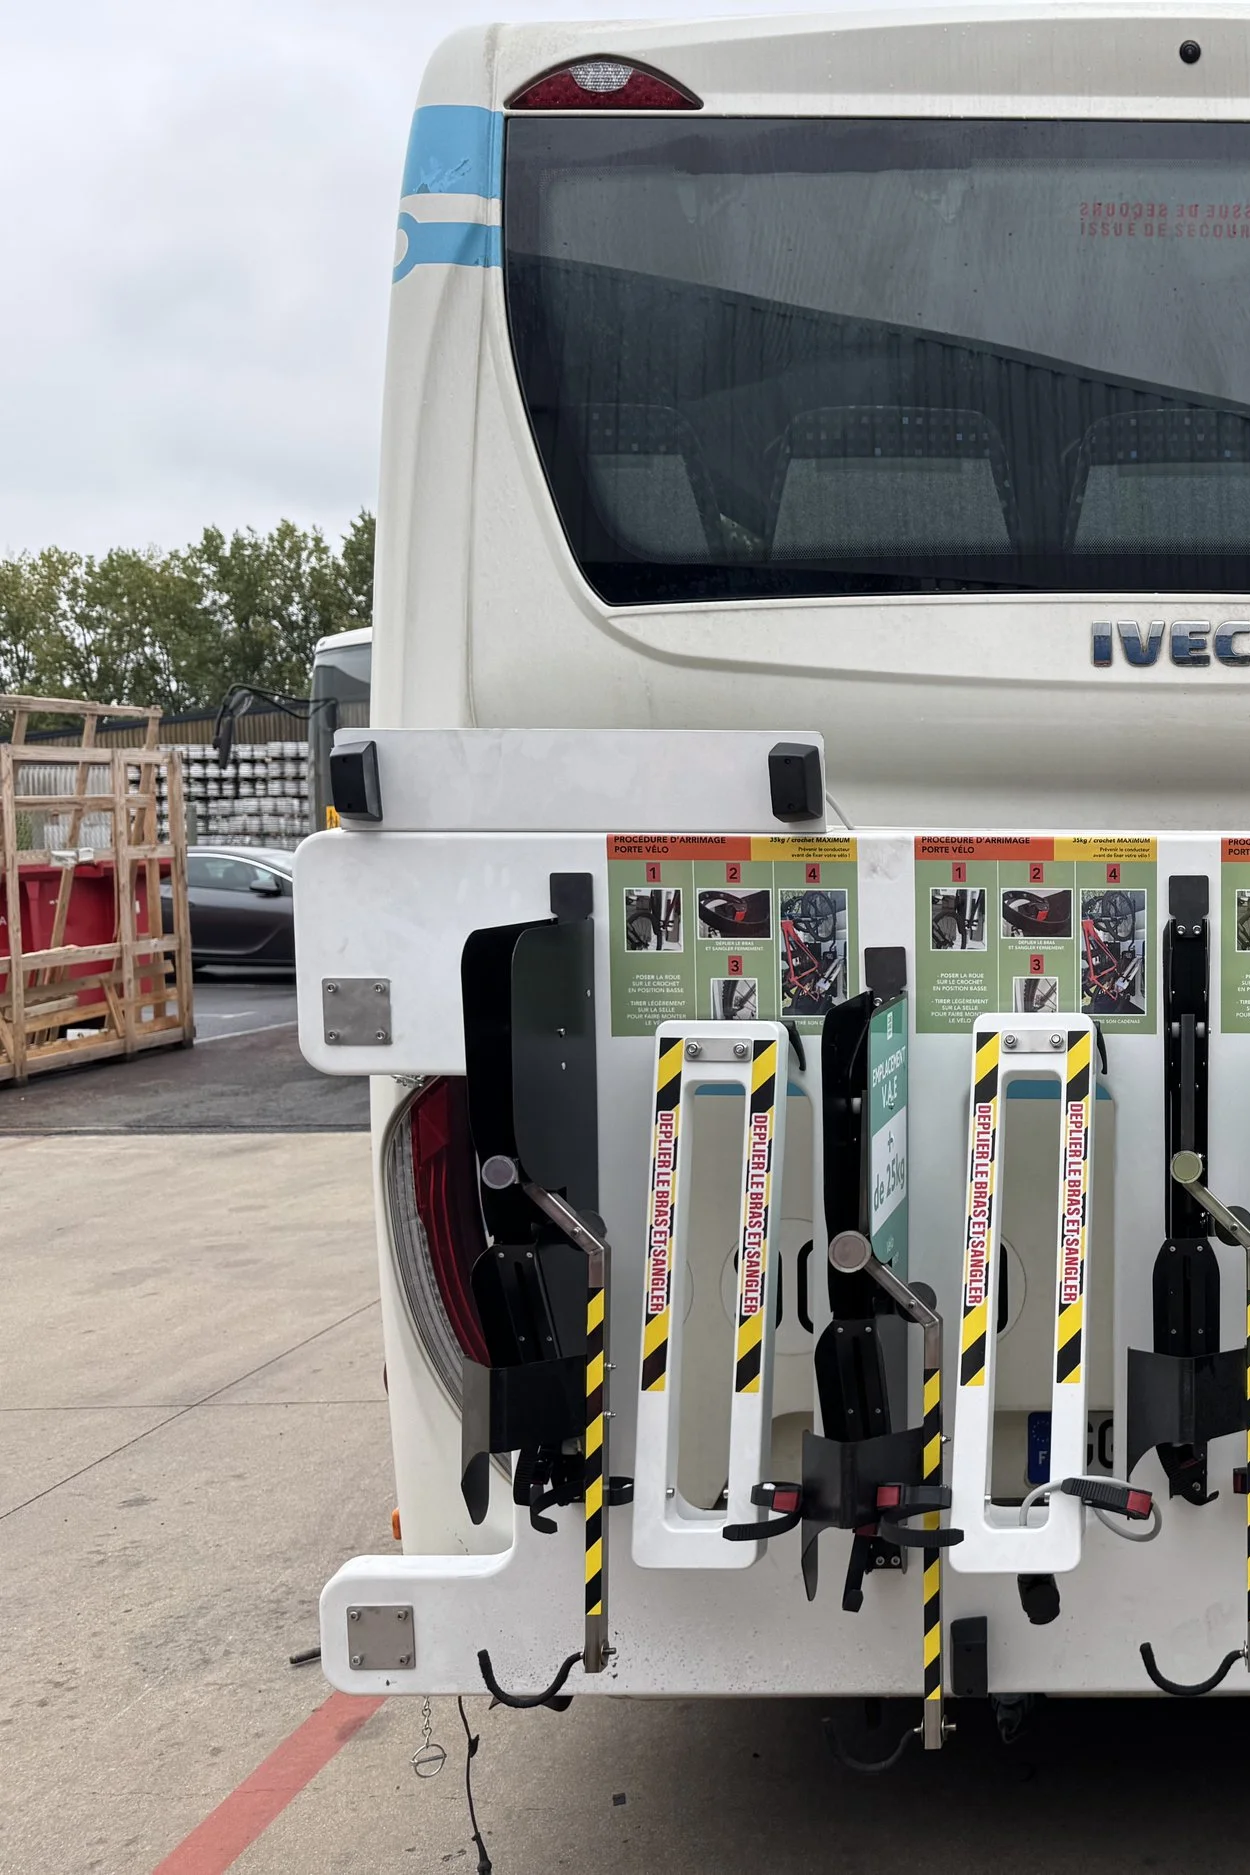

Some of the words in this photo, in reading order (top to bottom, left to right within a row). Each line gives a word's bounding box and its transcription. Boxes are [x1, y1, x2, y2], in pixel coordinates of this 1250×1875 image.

[1080, 222, 1135, 237] ISSUE
[1144, 222, 1166, 237] DE
[614, 835, 668, 844] PROCÉDURE
[670, 836, 726, 844] D'ARRIMAGE
[921, 836, 974, 844] PROCÉDURE
[614, 846, 643, 854] PORTE
[646, 844, 669, 854] VÉLO
[951, 844, 975, 854] VÉLO
[650, 867, 656, 879] 1
[729, 867, 738, 880] 2
[808, 868, 817, 880] 4
[955, 866, 961, 879] 1
[1032, 867, 1041, 880] 2
[1109, 868, 1118, 880] 4
[731, 960, 739, 972] 3
[1032, 959, 1041, 971] 3
[872, 1045, 906, 1088] EMPLACEMENT
[976, 1105, 991, 1160] DEPLIER
[1069, 1103, 1083, 1158] DEPLIER
[657, 1113, 673, 1169] DEPLIER
[752, 1115, 768, 1171] DEPLIER
[975, 1163, 989, 1178] LE
[1068, 1161, 1082, 1177] LE
[656, 1171, 671, 1188] LE
[751, 1173, 764, 1190] LE
[873, 1173, 885, 1212] de
[886, 1153, 905, 1197] 25kg
[973, 1181, 988, 1218] BRAS
[1067, 1179, 1081, 1216] BRAS
[655, 1190, 670, 1227] BRAS
[749, 1192, 764, 1229] BRAS
[972, 1221, 986, 1237] ET
[1066, 1219, 1080, 1235] ET
[654, 1230, 668, 1247] ET
[747, 1232, 762, 1248] ET
[968, 1240, 985, 1304] SANGLER
[1063, 1239, 1079, 1302] SANGLER
[650, 1249, 667, 1312] SANGLER
[744, 1251, 761, 1314] SANGLER
[1038, 1450, 1048, 1465] F
